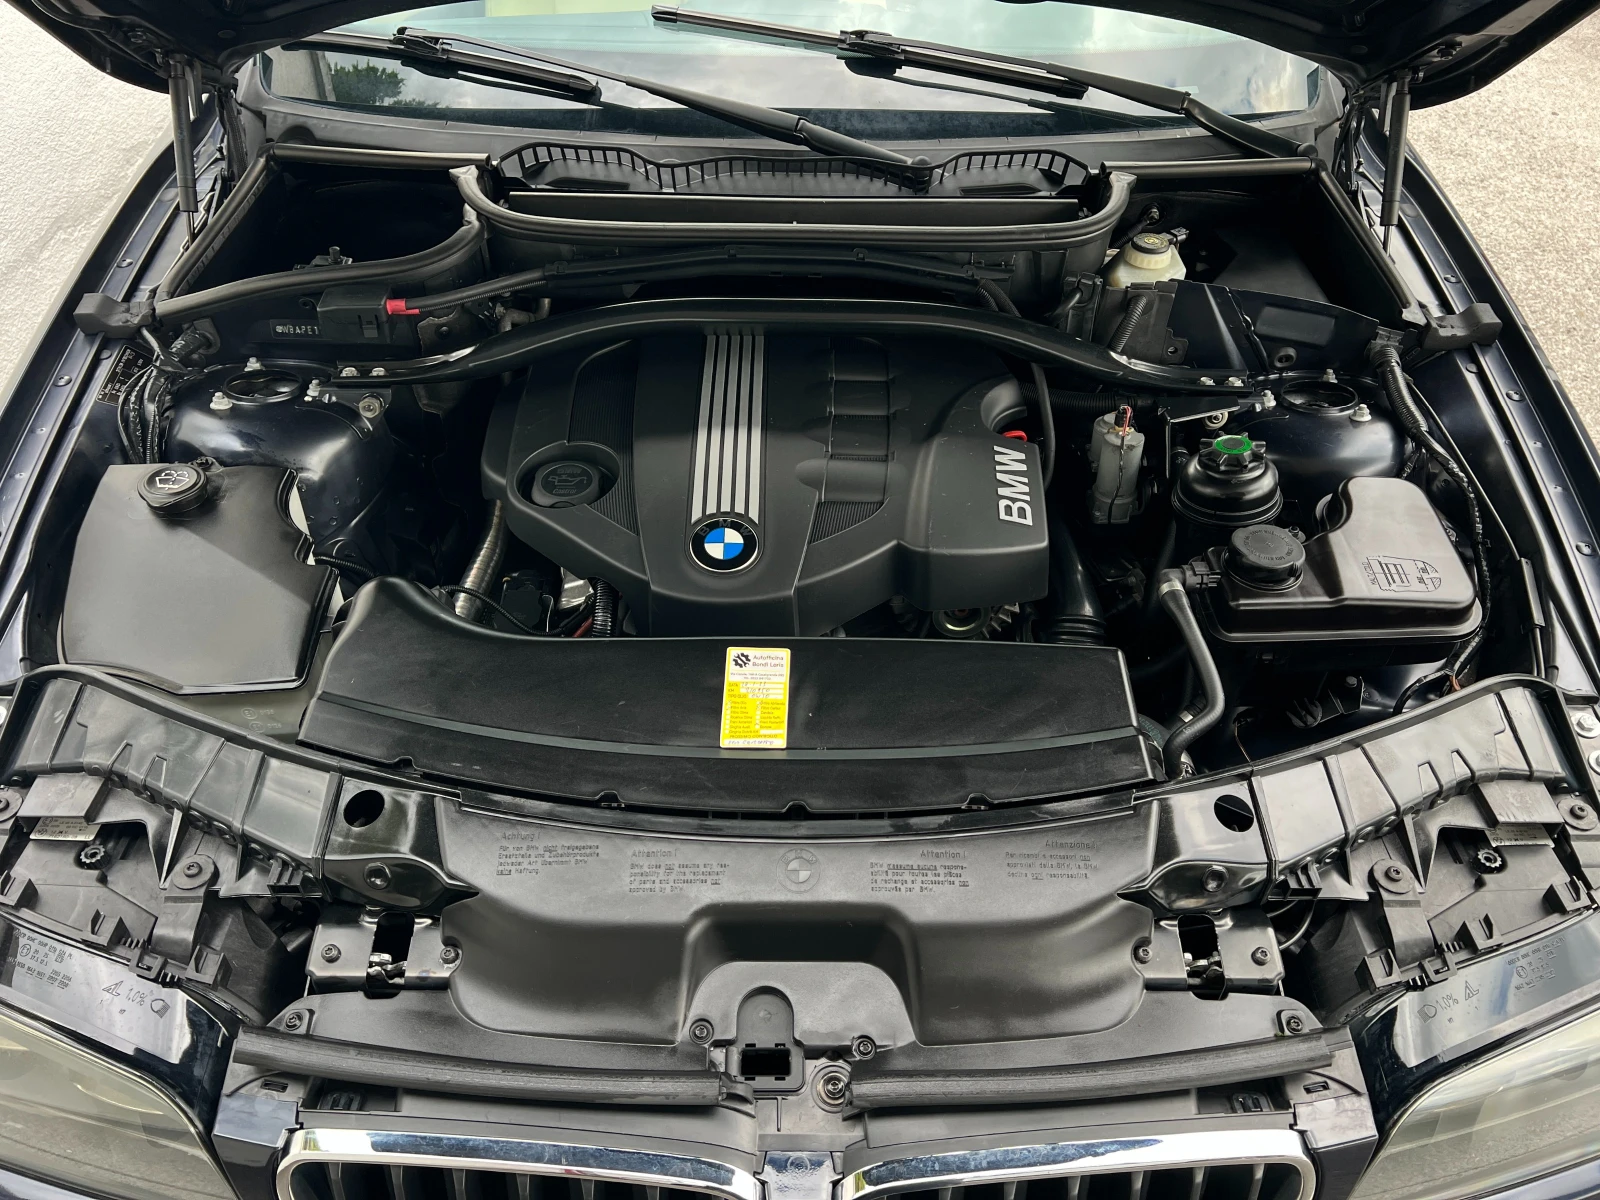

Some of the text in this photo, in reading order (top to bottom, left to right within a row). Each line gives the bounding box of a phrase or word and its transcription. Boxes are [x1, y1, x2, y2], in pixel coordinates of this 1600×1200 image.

[993, 445, 1033, 526] BMW
[698, 519, 752, 537] BMW
[502, 832, 534, 841] Achtung
[1046, 840, 1090, 849] Attenzione
[631, 849, 672, 858] Attention
[920, 850, 960, 858] Attention
